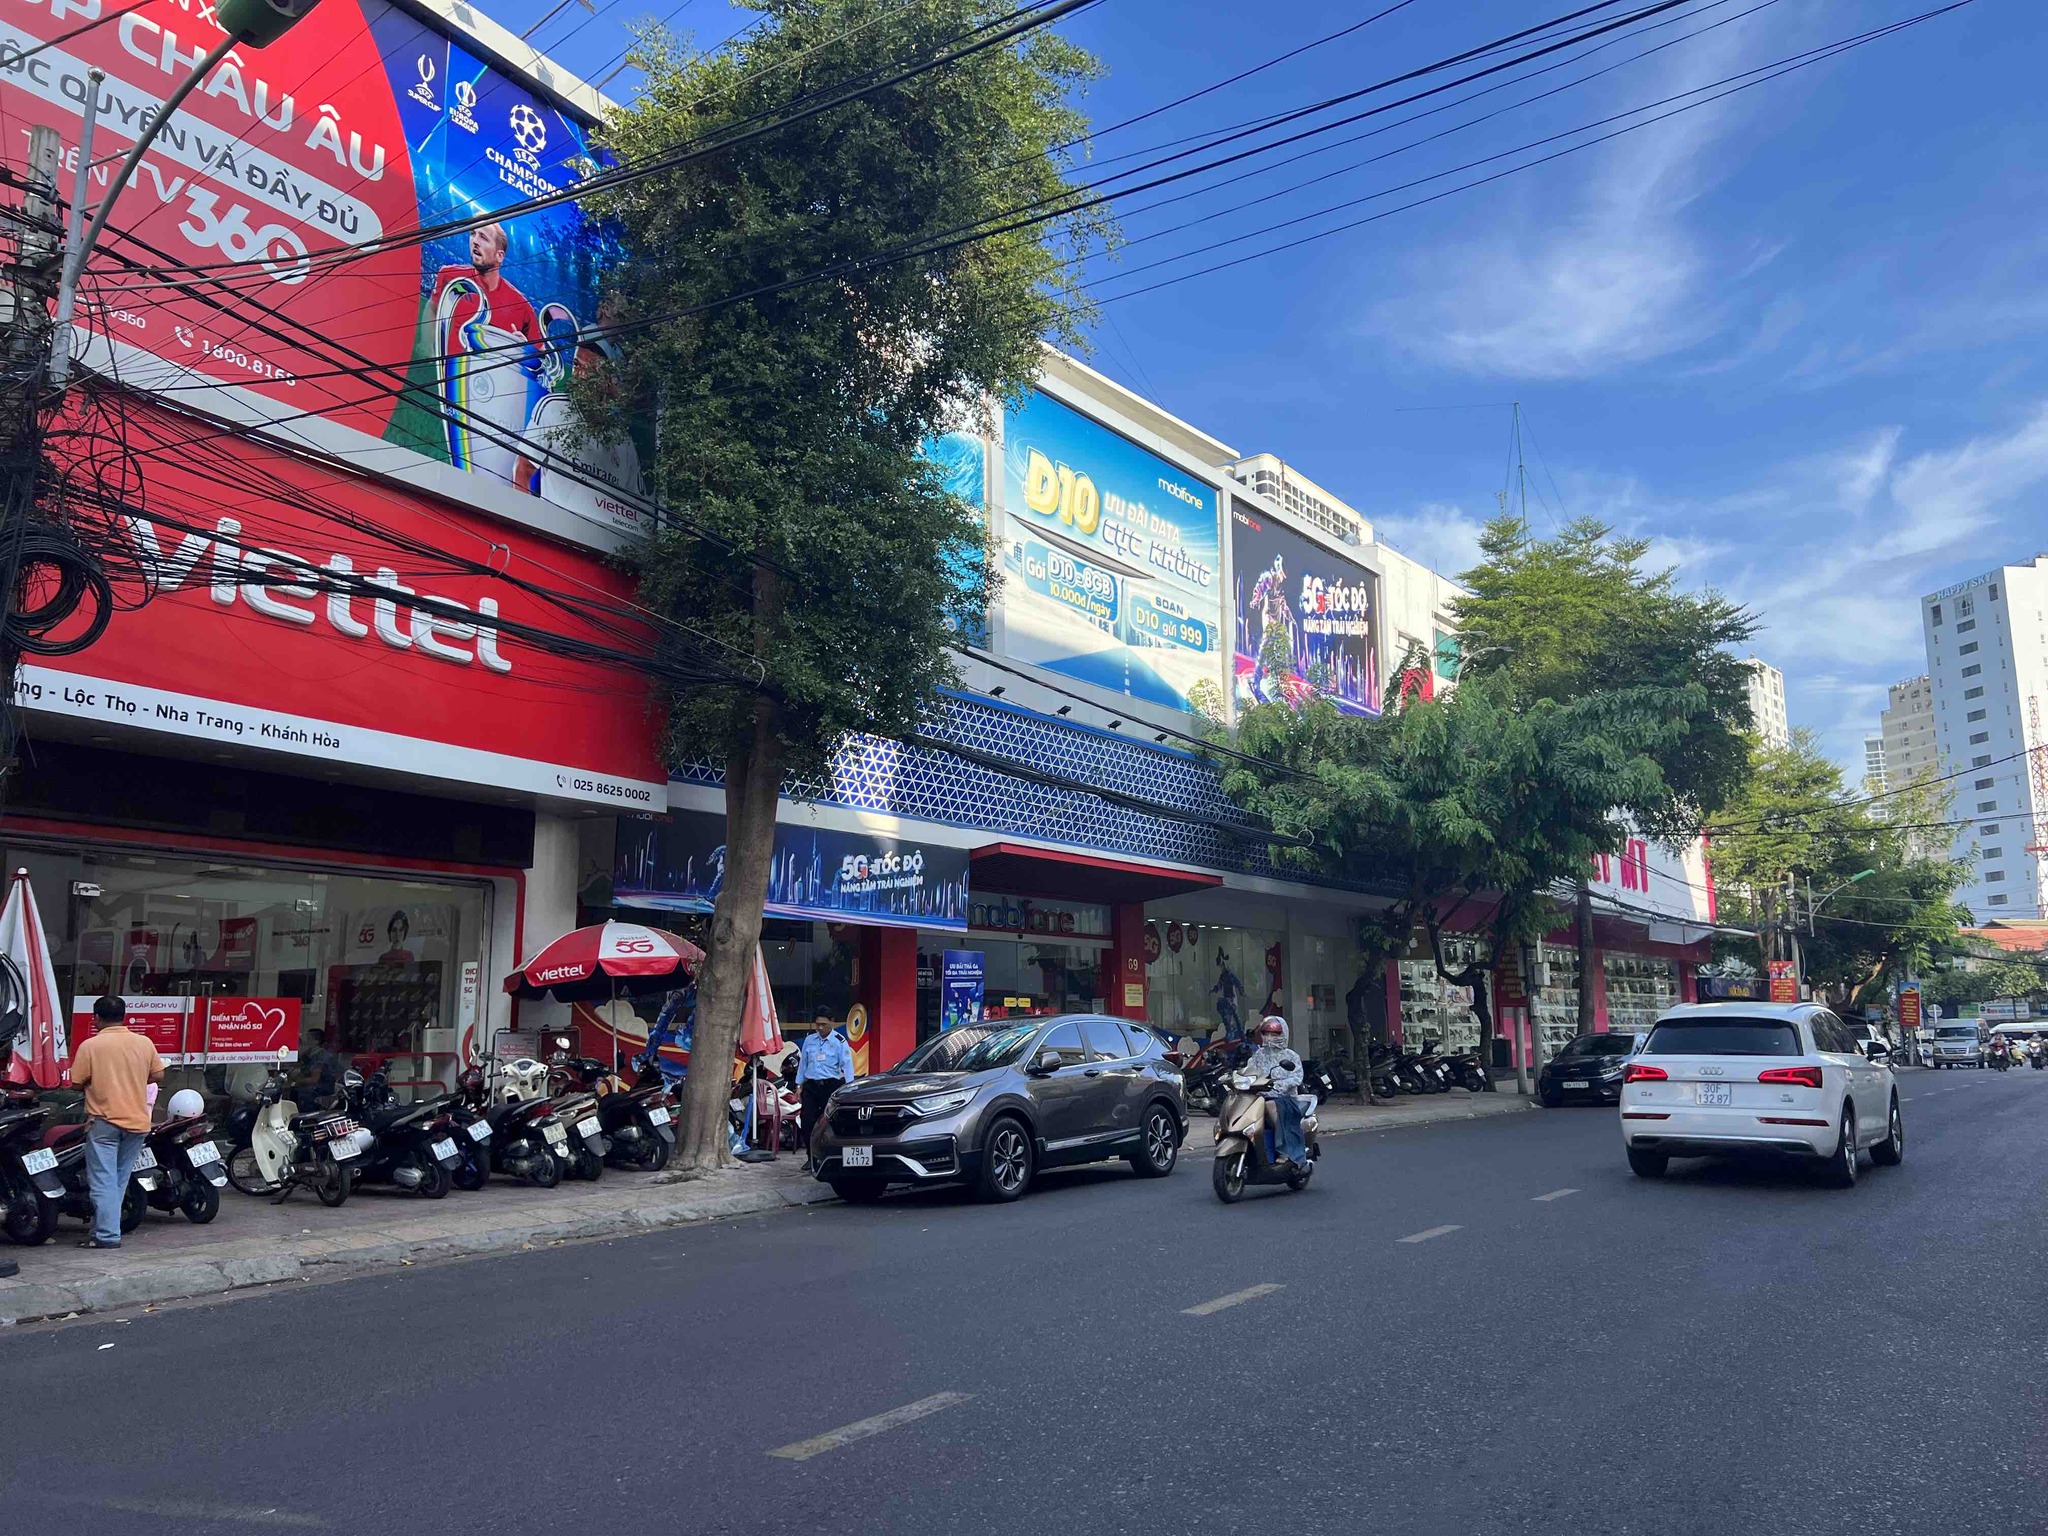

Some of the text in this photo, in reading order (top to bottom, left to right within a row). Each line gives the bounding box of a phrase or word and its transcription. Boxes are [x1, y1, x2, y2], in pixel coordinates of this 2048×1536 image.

[119, 11, 294, 133] CHÂU
[305, 103, 385, 182] ÂU
[59, 73, 187, 151] QUYỀN
[194, 136, 239, 178] VÀ
[245, 164, 312, 209] ĐẦY
[317, 199, 359, 235] ĐỦ
[514, 149, 540, 172] UEFA
[499, 167, 550, 202] LEAGU
[1023, 447, 1100, 535] D10
[1158, 477, 1204, 511] mobifone
[594, 496, 640, 523] viettel
[1233, 510, 1263, 532] mobifone
[612, 517, 640, 533] telecom
[1150, 514, 1181, 542] DATA
[1102, 518, 1212, 588] CỰC KHỦNG
[1026, 554, 1047, 582] Gói
[1049, 553, 1075, 582] D10
[1084, 568, 1113, 600] 8GB
[1937, 572, 1993, 600] HAPPY SKY
[124, 514, 513, 674] viettel
[1303, 573, 1326, 615] 5G
[1136, 607, 1159, 631] D10
[1179, 623, 1203, 647] 999
[64, 687, 96, 708] Lộc
[105, 694, 137, 717] Thọ
[156, 703, 189, 723] Nha
[196, 711, 244, 736] Trang
[261, 723, 308, 744] Khánh
[312, 732, 341, 749] Hòa
[573, 778, 652, 802] 025 8625 0002
[841, 849, 924, 881] 5G TỐC ĐỘ
[615, 939, 655, 954] 5G
[535, 963, 586, 982] viettel
[1127, 957, 1139, 972] 69
[218, 1023, 240, 1031] NHẬN
[231, 1012, 248, 1022] TIẾP
[1704, 1083, 1721, 1094] 30F
[851, 1147, 864, 1157] 79A
